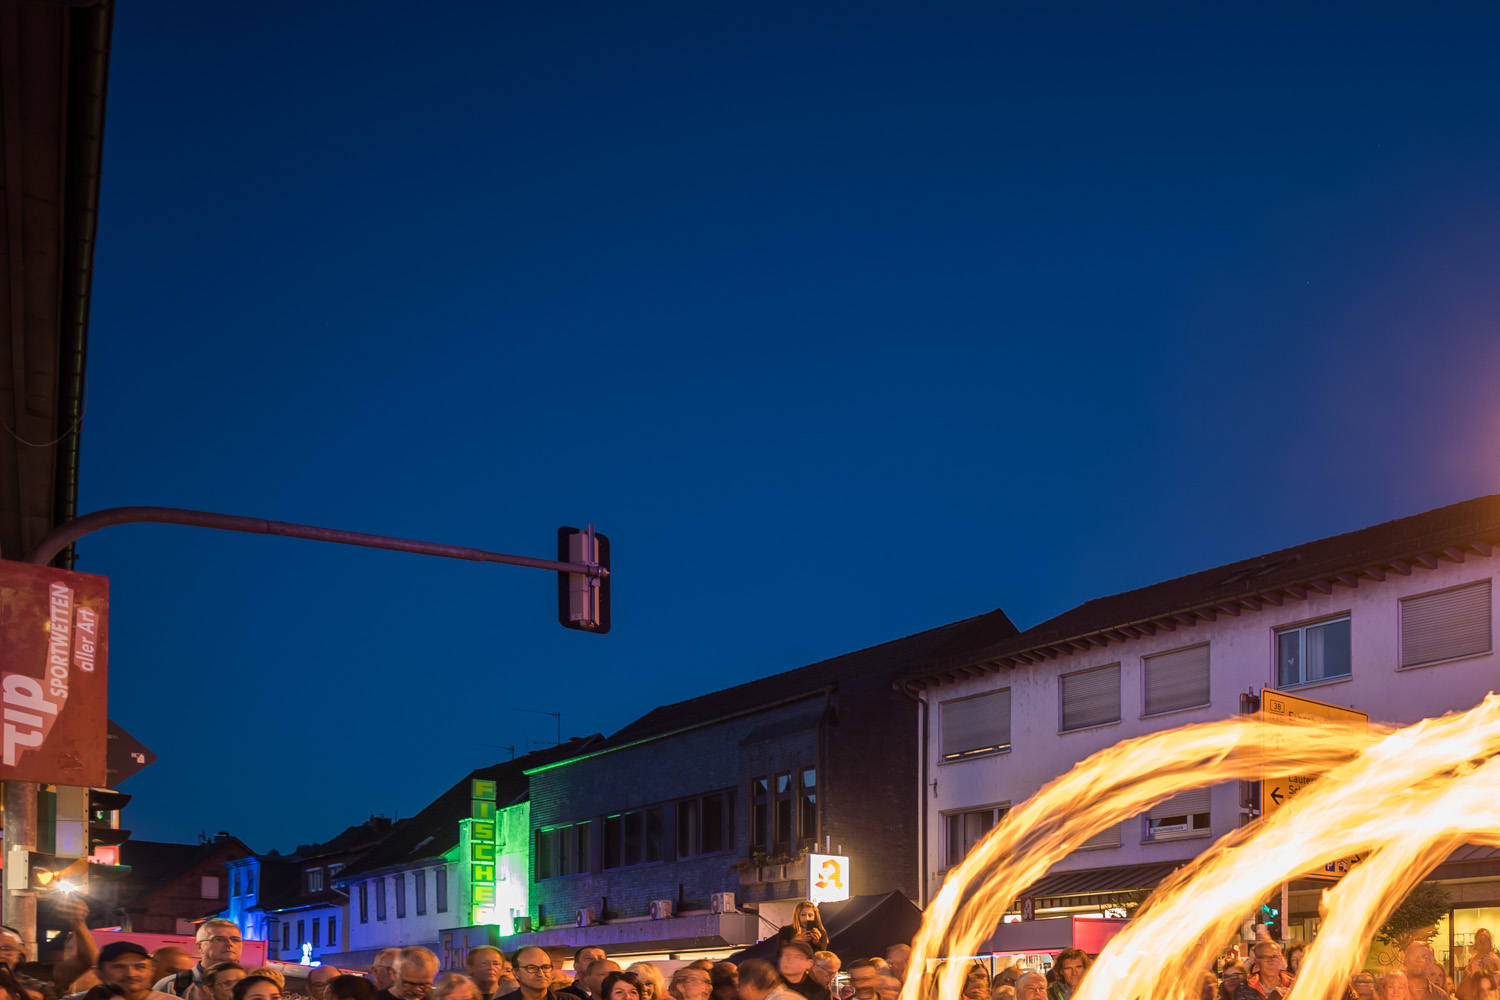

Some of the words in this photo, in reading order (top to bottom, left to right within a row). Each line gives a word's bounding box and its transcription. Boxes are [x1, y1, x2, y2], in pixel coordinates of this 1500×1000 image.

[78, 609, 95, 634] Art
[51, 584, 70, 698] SPORTWETTEN
[76, 638, 95, 672] aller
